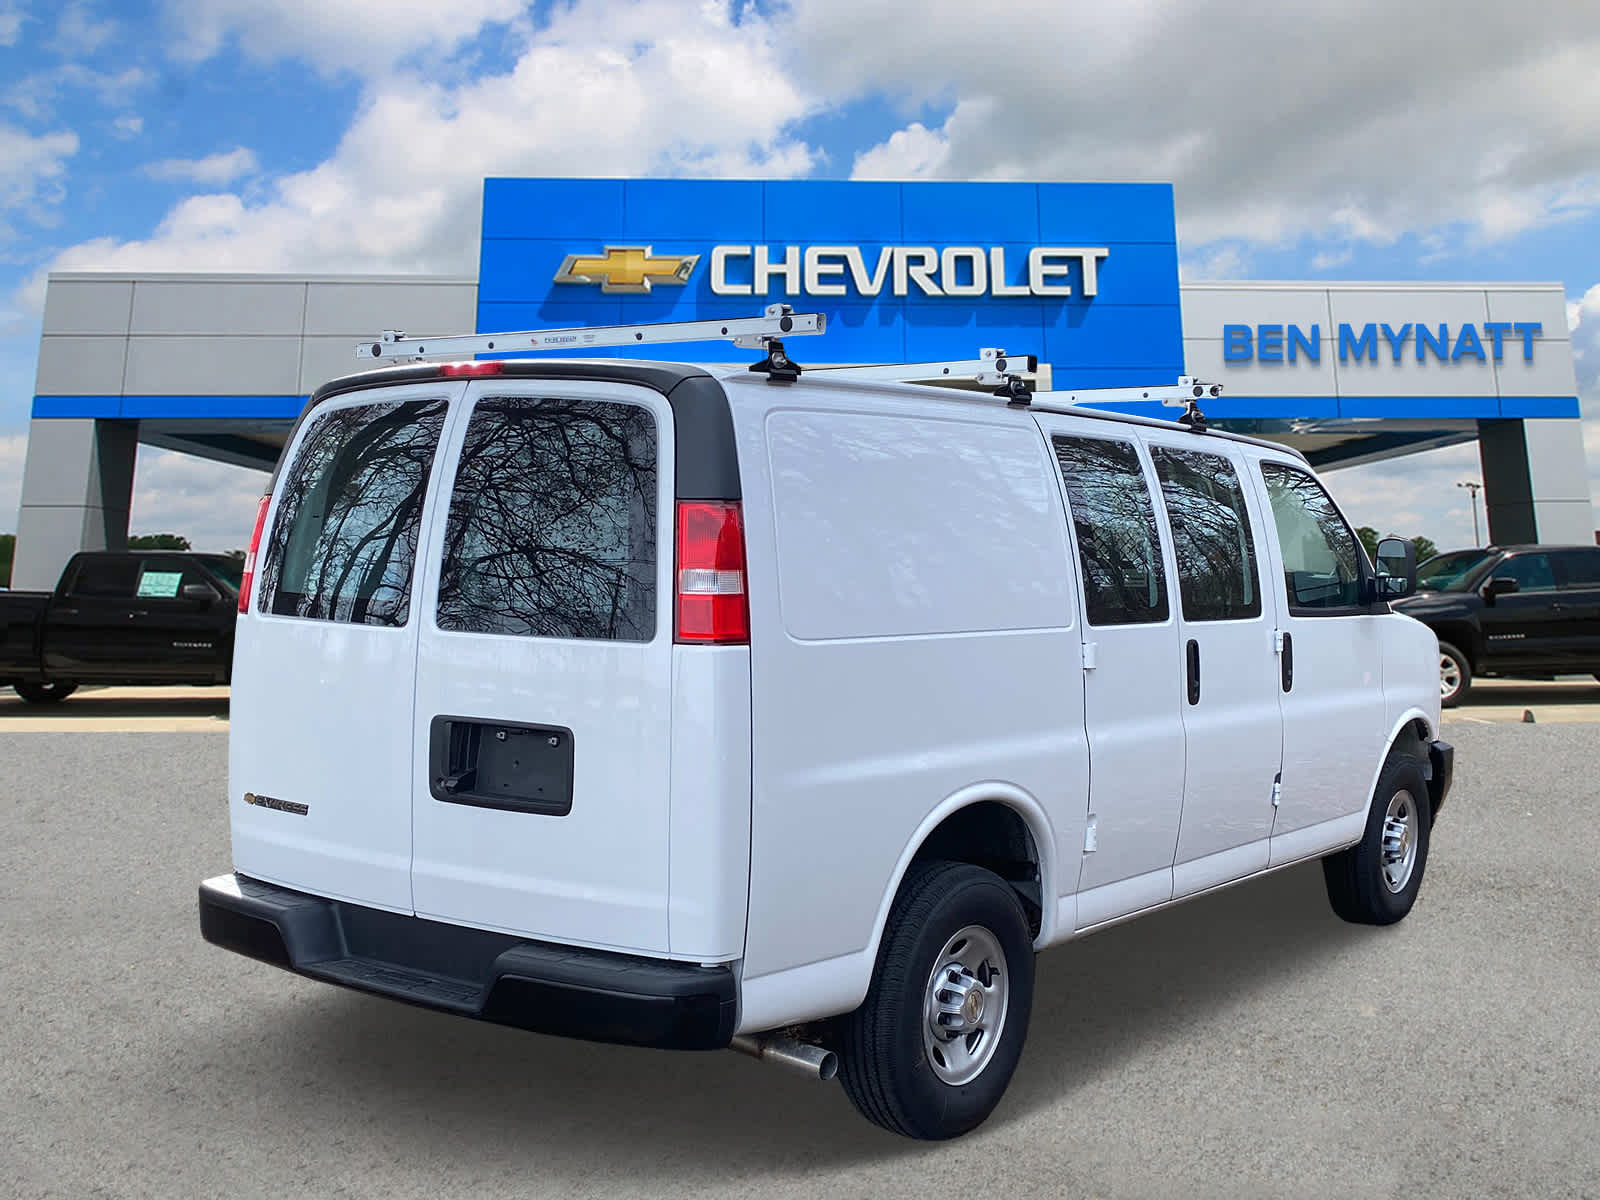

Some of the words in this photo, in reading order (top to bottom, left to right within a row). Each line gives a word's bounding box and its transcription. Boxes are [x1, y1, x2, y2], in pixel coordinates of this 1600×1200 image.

[711, 245, 1109, 296] CHEVROLET
[1224, 324, 1321, 361] BEN
[1338, 322, 1542, 361] MYNATT
